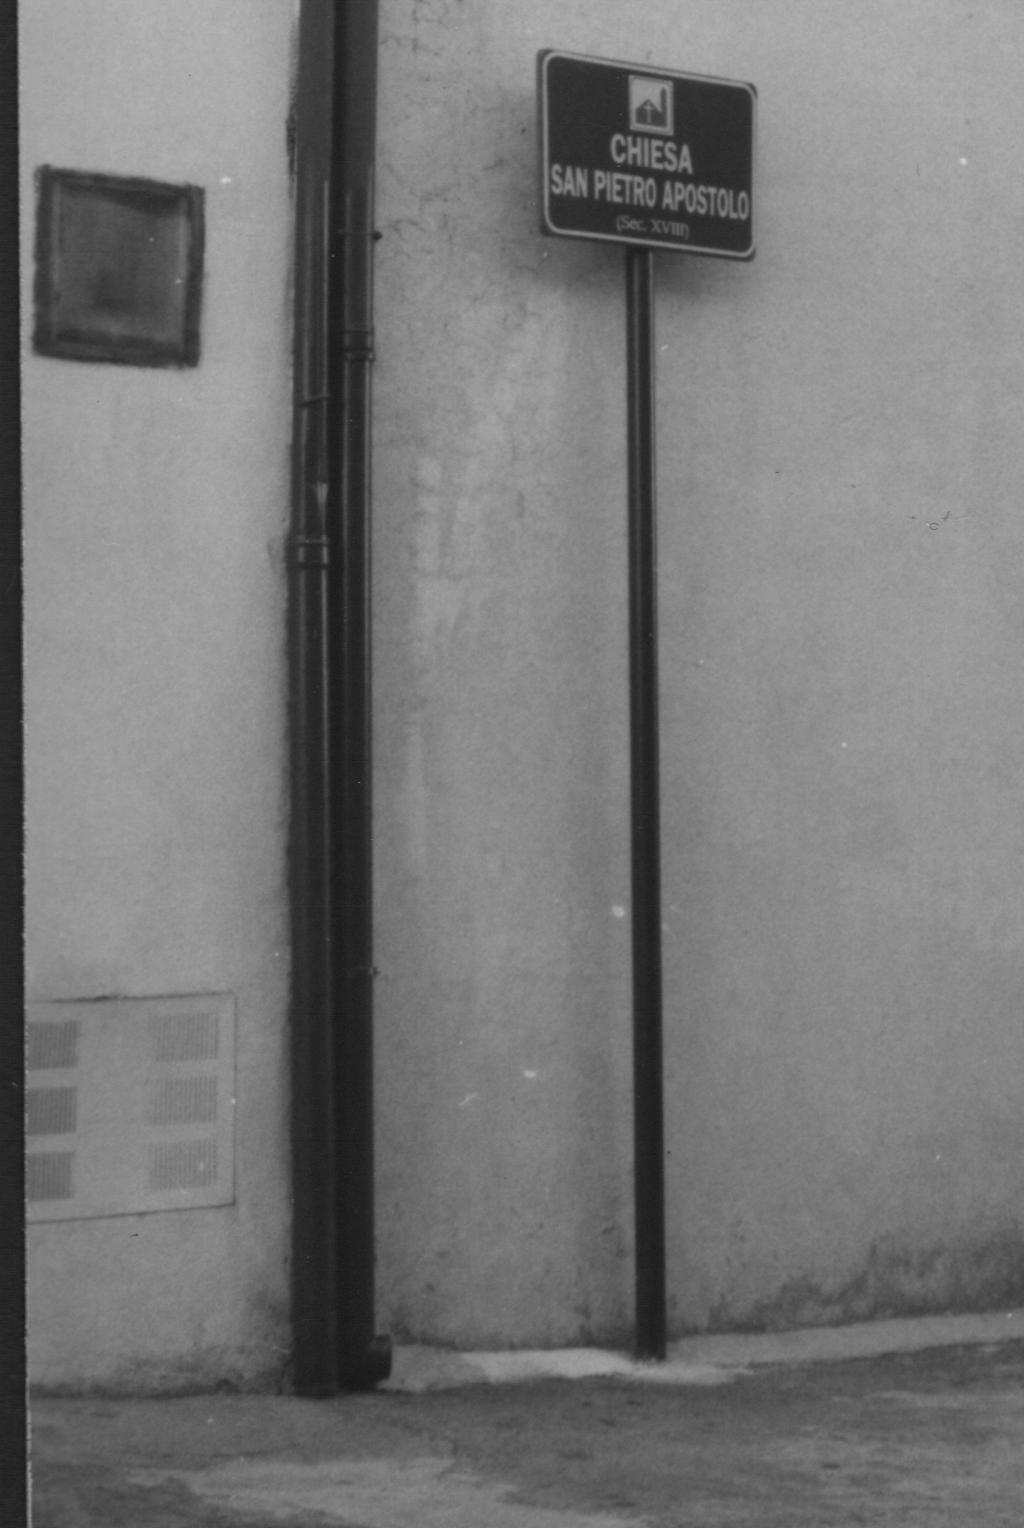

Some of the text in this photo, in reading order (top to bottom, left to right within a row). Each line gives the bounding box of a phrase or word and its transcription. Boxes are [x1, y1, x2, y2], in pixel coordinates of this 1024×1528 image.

[610, 133, 693, 174] CHIESA
[551, 164, 750, 220] SAN PIETRO APOSTOLO
[616, 214, 690, 241] (Sec. XVIII)
